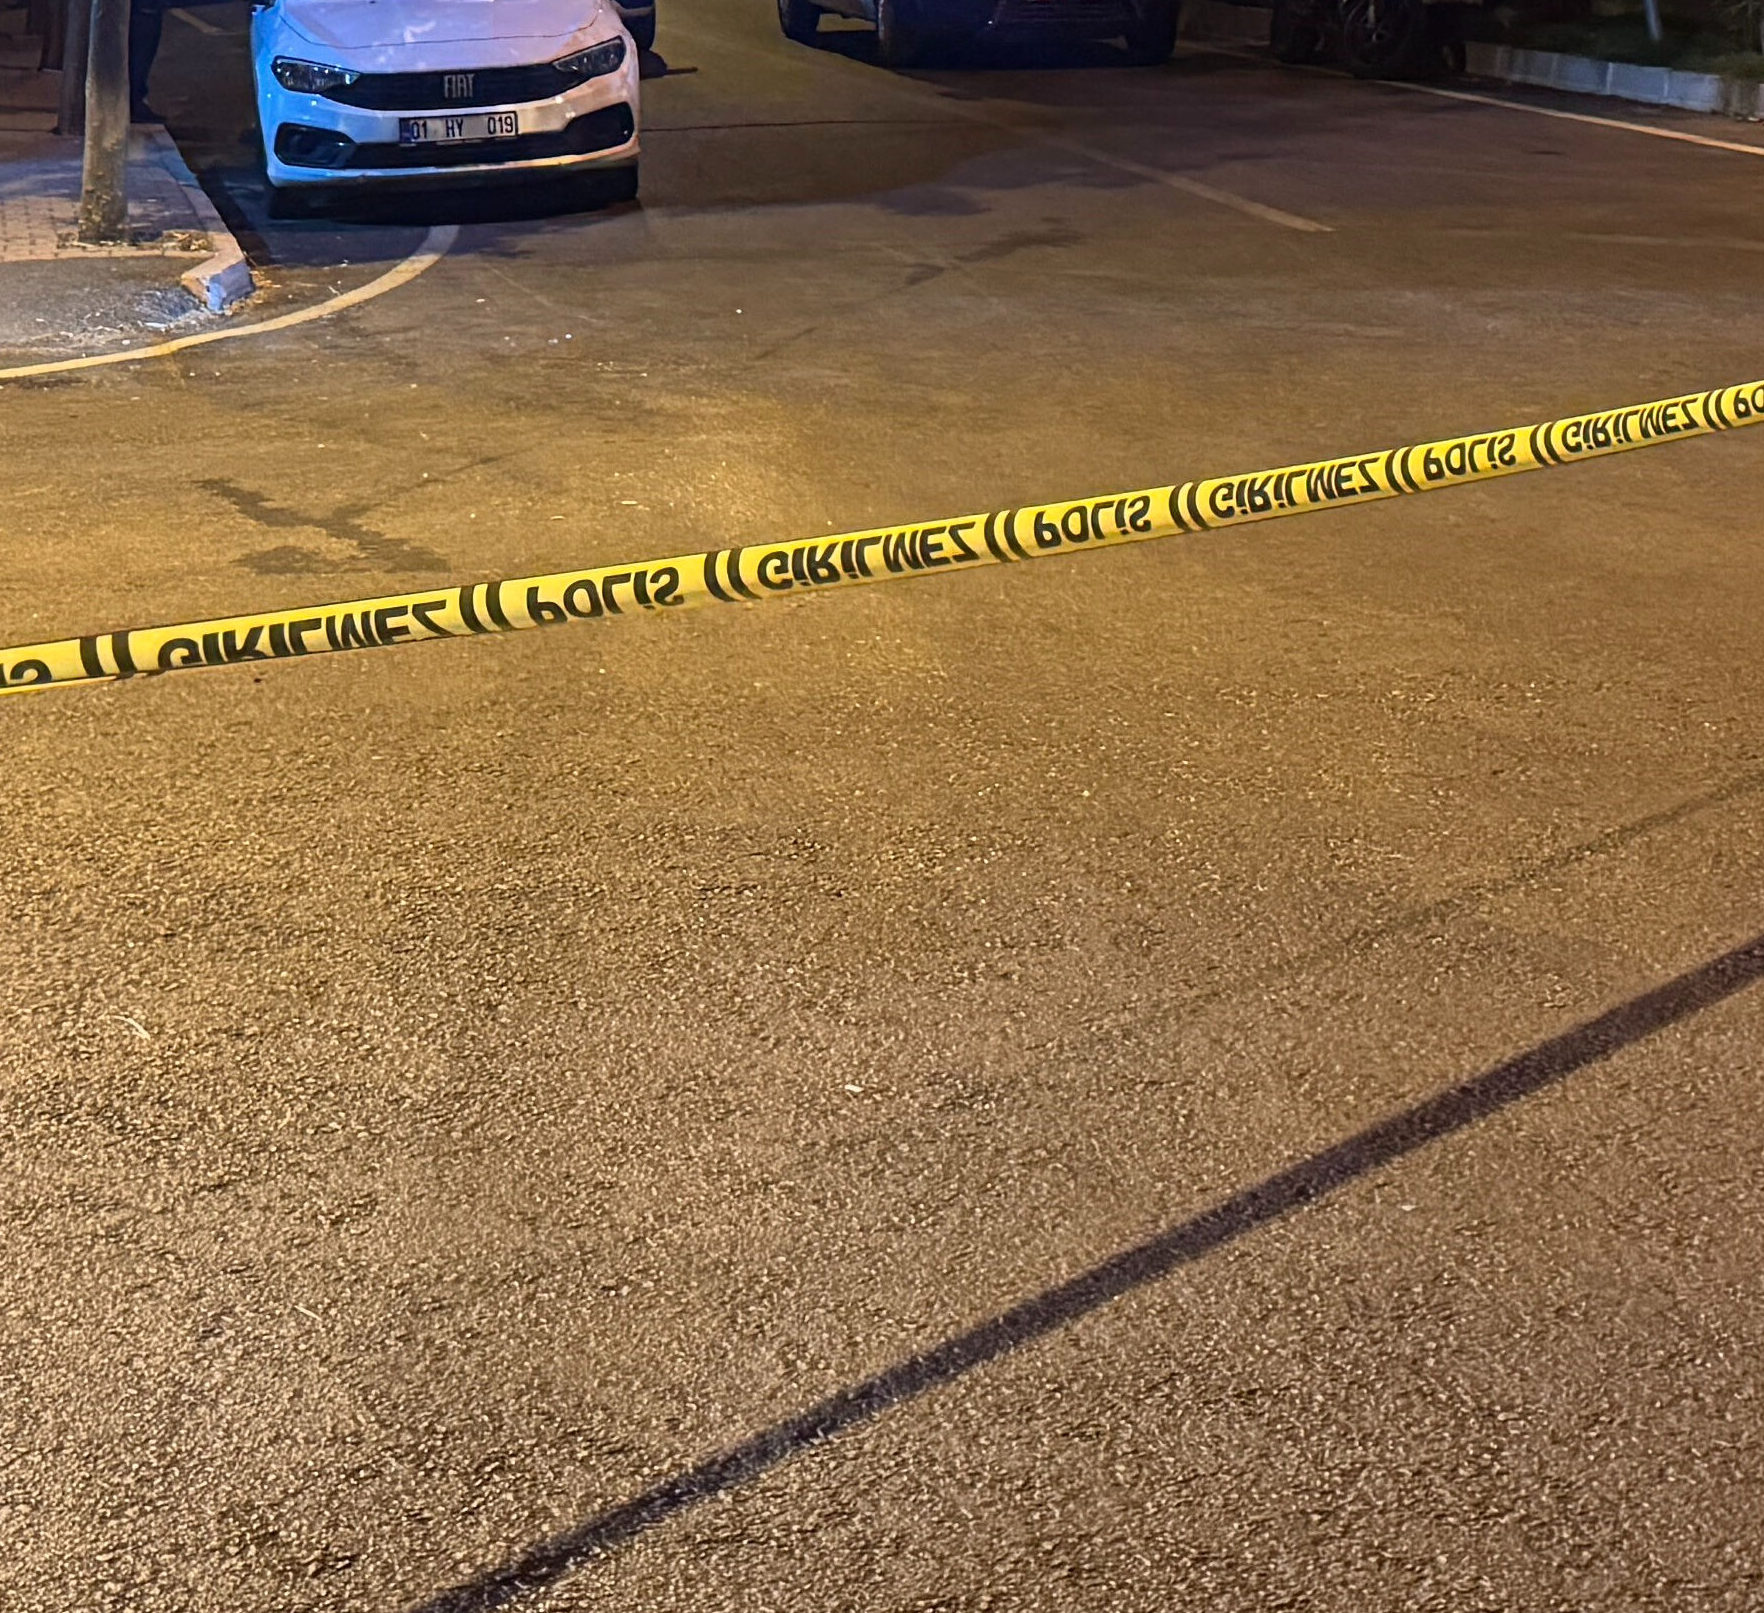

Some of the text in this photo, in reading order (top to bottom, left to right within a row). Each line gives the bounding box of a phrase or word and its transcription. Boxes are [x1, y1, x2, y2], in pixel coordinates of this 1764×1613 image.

[443, 73, 475, 99] FIAT
[411, 115, 514, 140] 01 HY 019
